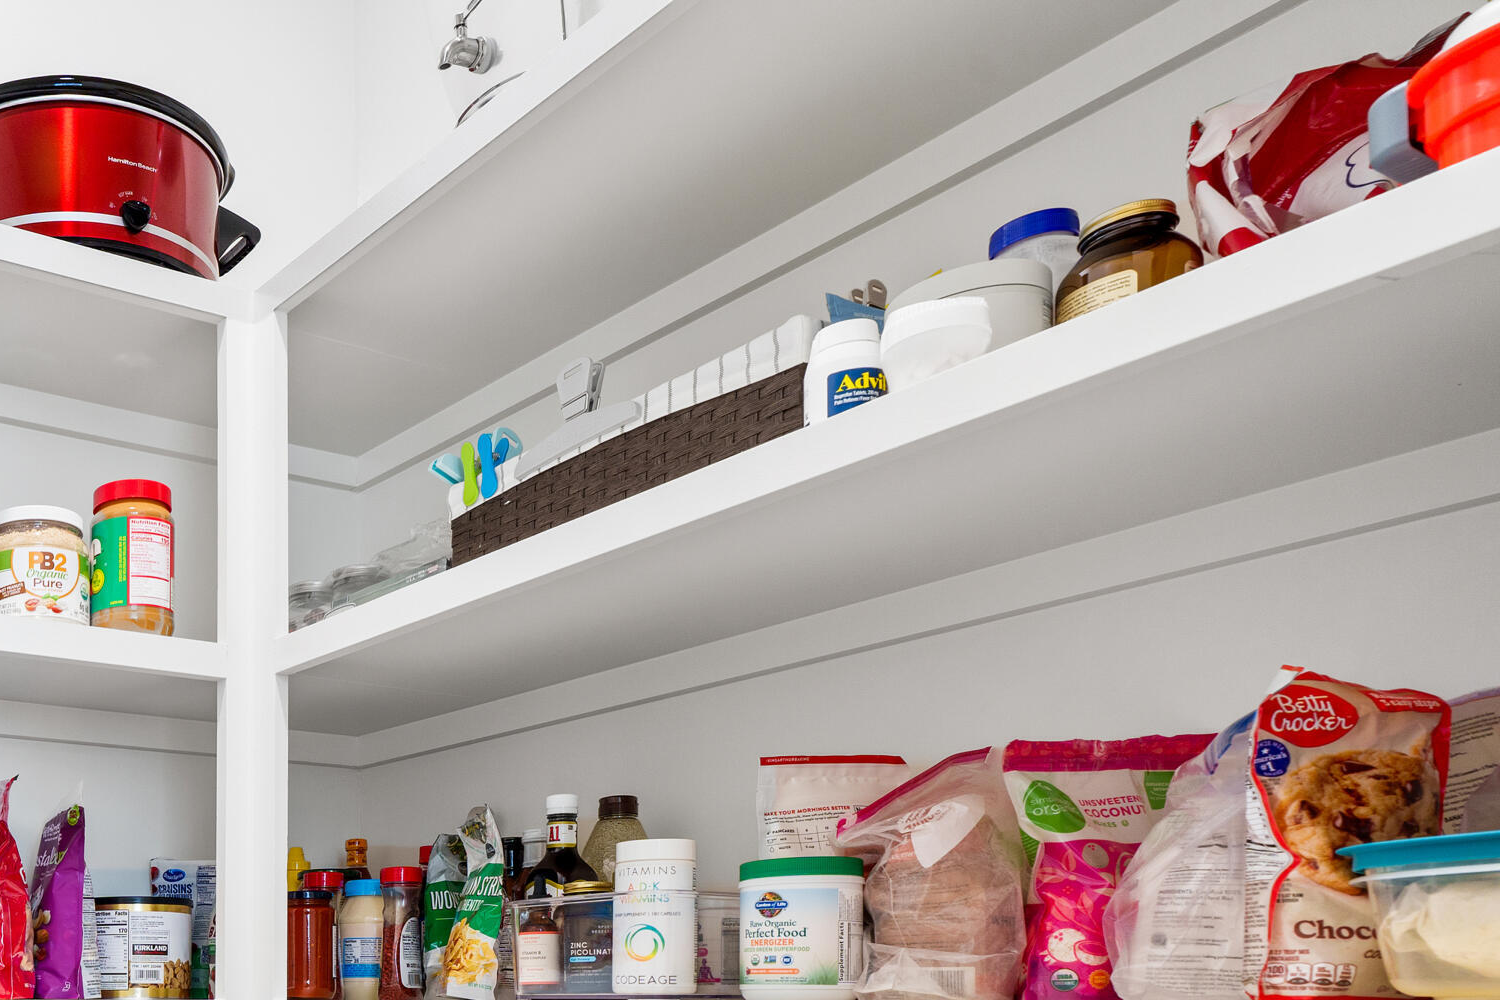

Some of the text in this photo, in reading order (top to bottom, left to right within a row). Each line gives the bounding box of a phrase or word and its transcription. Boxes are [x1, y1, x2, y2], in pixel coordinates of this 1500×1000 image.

[107, 156, 157, 173] Hamilton Beach
[836, 371, 886, 393] Advil
[29, 551, 67, 572] PB2
[26, 568, 68, 581] Organic
[33, 577, 63, 589] Pure
[1277, 695, 1336, 716] Betty
[1271, 709, 1354, 732] Crocker
[618, 865, 677, 877] VITAMINS
[158, 884, 192, 894] CRAISINS
[764, 920, 796, 928] Organic
[745, 927, 807, 938] Perfect Food
[134, 944, 168, 952] KIRKLAND
[615, 975, 677, 985] CODEAGE
